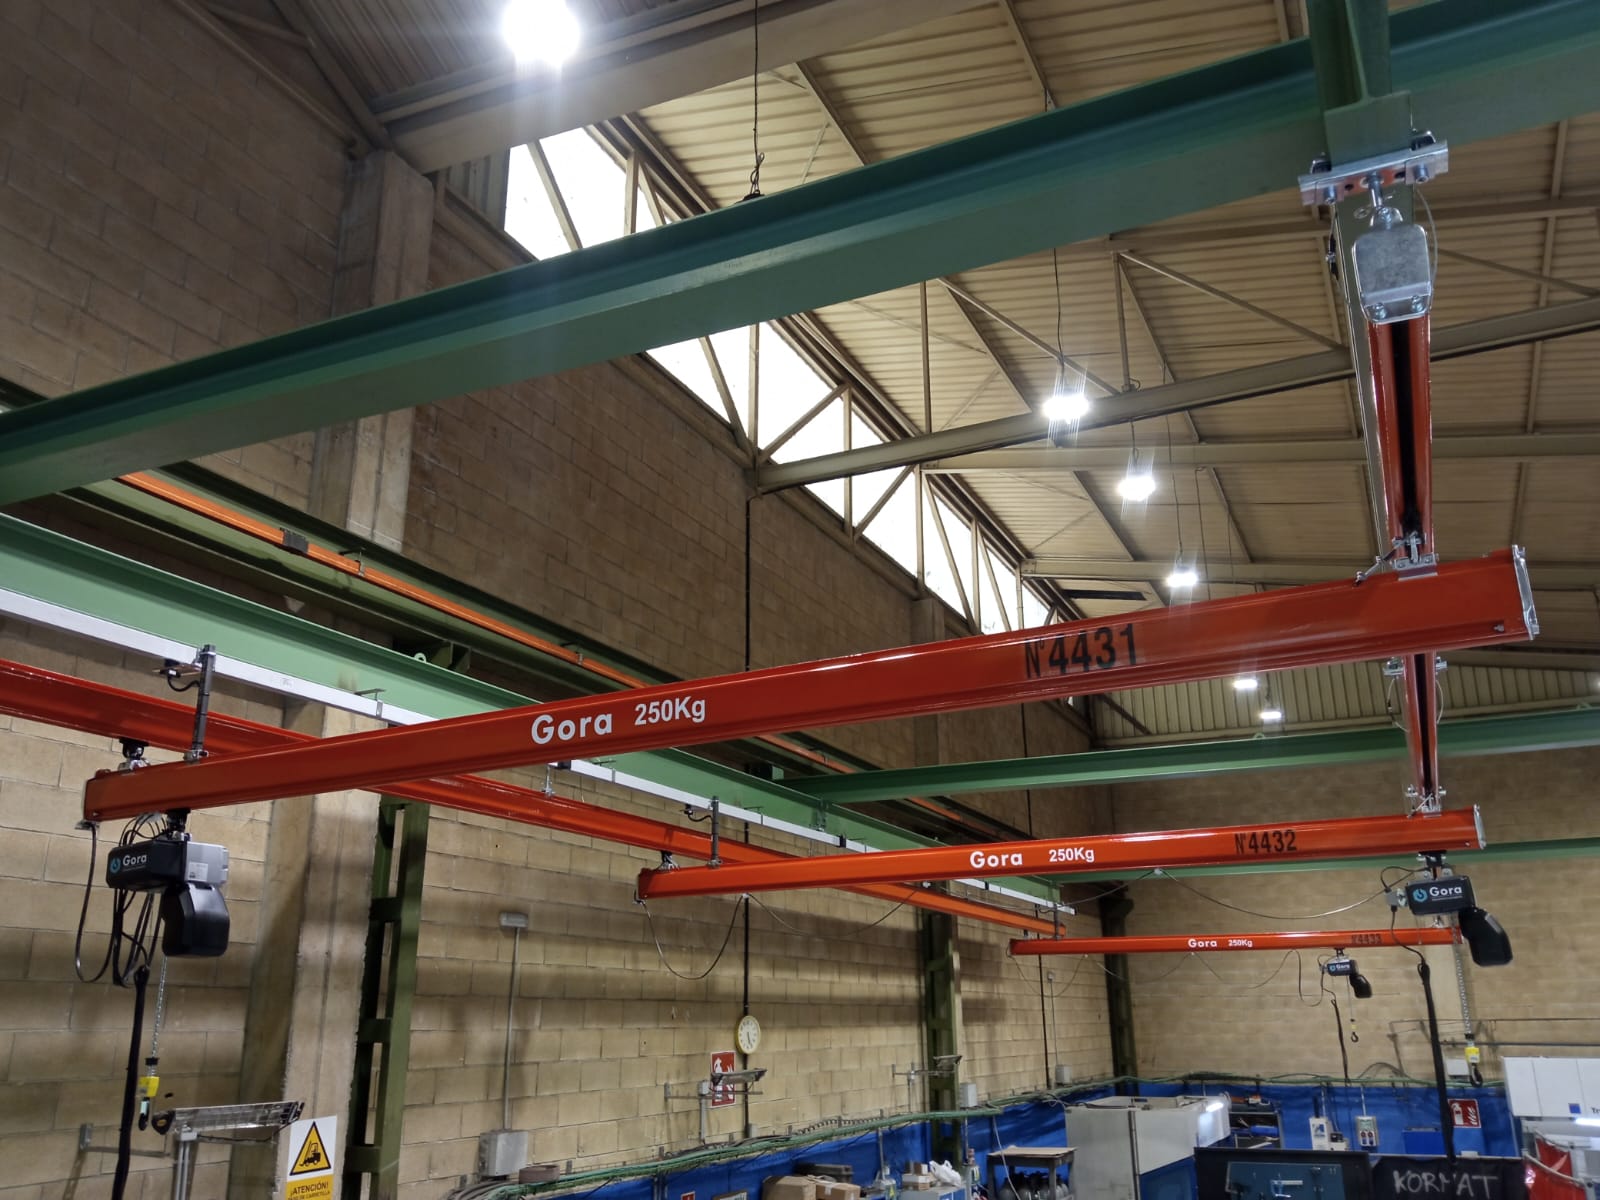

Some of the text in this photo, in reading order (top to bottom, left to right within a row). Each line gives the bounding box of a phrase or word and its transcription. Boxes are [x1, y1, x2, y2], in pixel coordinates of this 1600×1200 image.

[531, 695, 706, 745] Gora 250Kg
[122, 854, 147, 867] Gora
[969, 846, 1095, 868] Gora 250Kg
[1429, 886, 1463, 897] Gora
[1187, 938, 1253, 948] Gora 250Kg
